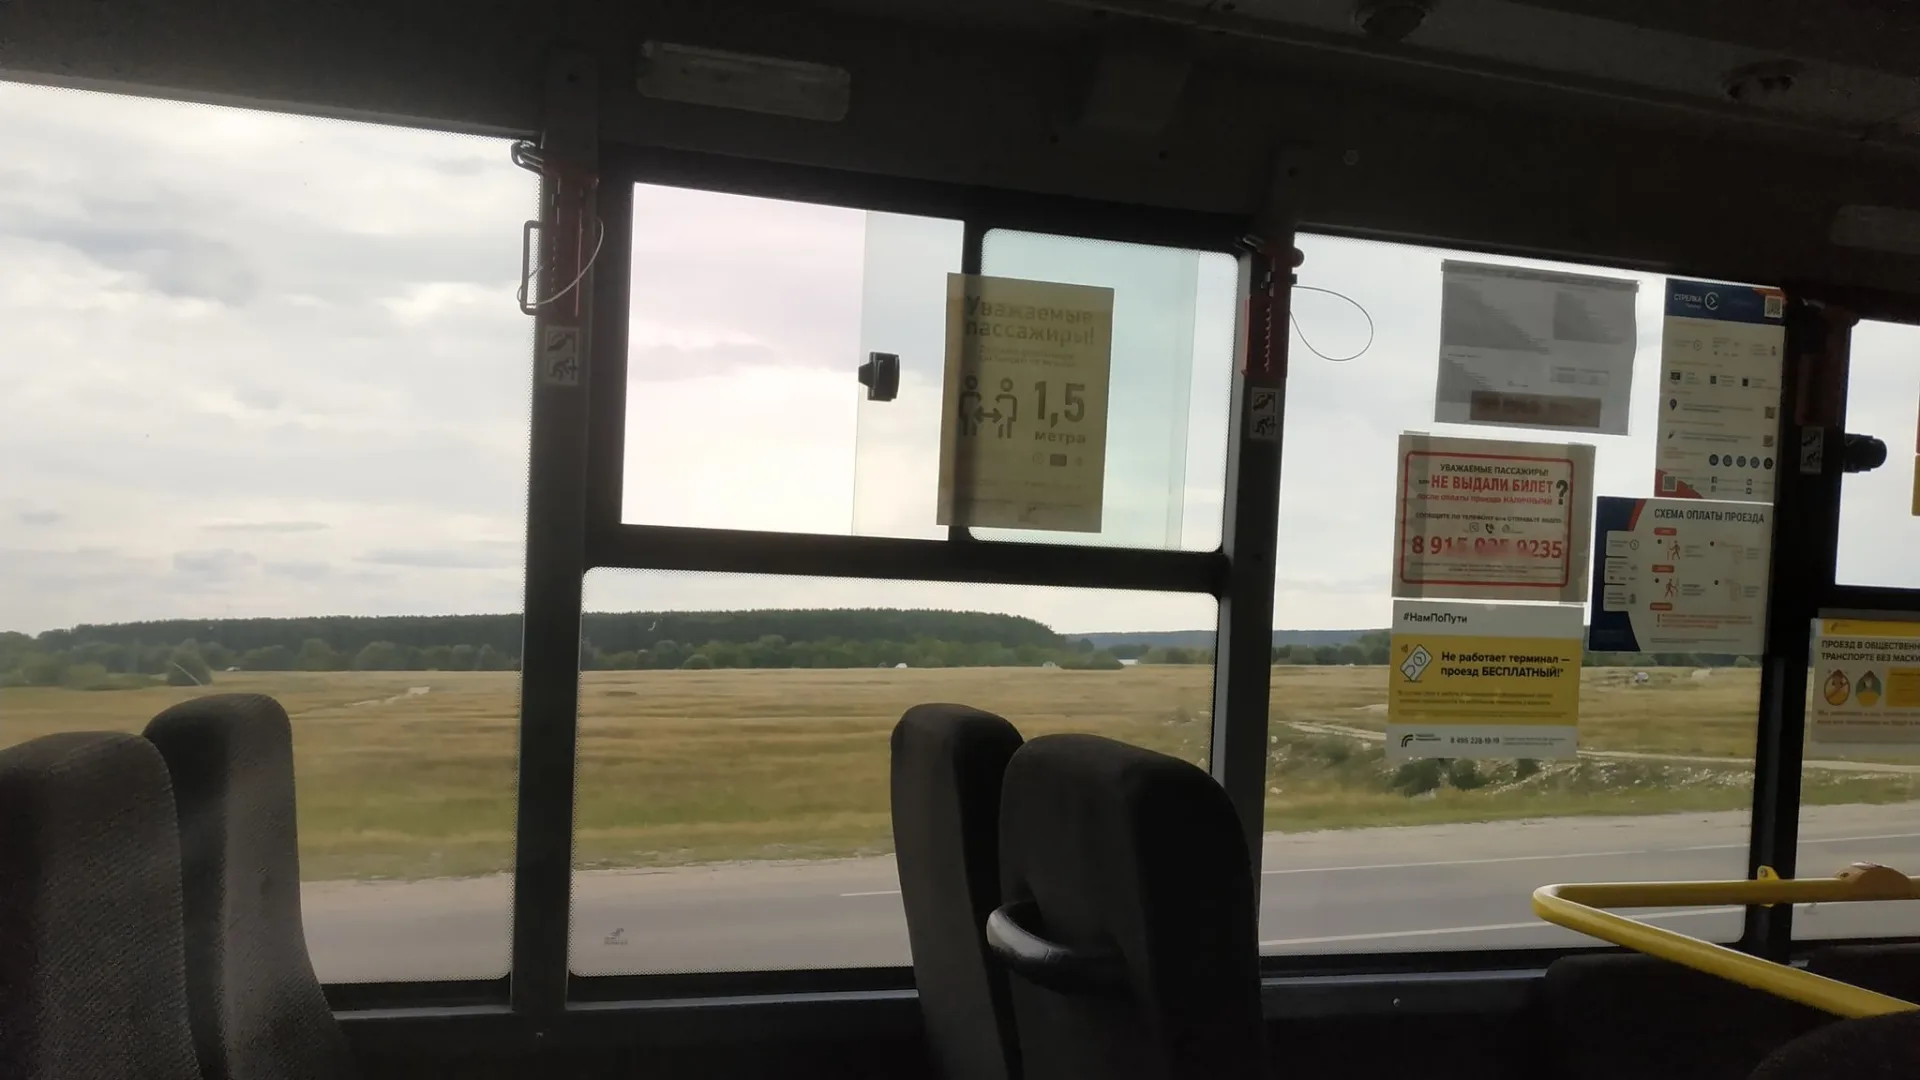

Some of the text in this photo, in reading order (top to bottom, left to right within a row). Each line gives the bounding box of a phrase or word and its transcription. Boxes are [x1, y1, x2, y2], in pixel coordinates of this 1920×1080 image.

[966, 295, 1094, 324] Уважаемые
[965, 320, 1095, 347] пассажиры!
[1034, 380, 1085, 428] 1,5
[1034, 430, 1086, 446] метра
[1440, 463, 1549, 476] УВАЖАЕМЫЕ ПАССАЖИРЫ!
[1431, 474, 1449, 489] НЕ
[1452, 476, 1509, 493] ВЫДАЛИ
[1512, 479, 1554, 494] БИЛЕТ
[1654, 508, 1765, 524] СХЕМА ОПЛАТЫ ПРОЕЗДА
[1411, 535, 1425, 554] 8
[1403, 611, 1468, 625] #НамПоПути
[1821, 640, 1855, 649] ПРОЕЗД
[1857, 641, 1863, 649] В
[1441, 651, 1456, 662] Не
[1459, 652, 1507, 665] работает
[1509, 653, 1559, 665] терминал
[1821, 652, 1874, 661] ТРАНСПОРТЕ
[1876, 653, 1891, 661] БЕЗ
[1440, 667, 1479, 678] проезд
